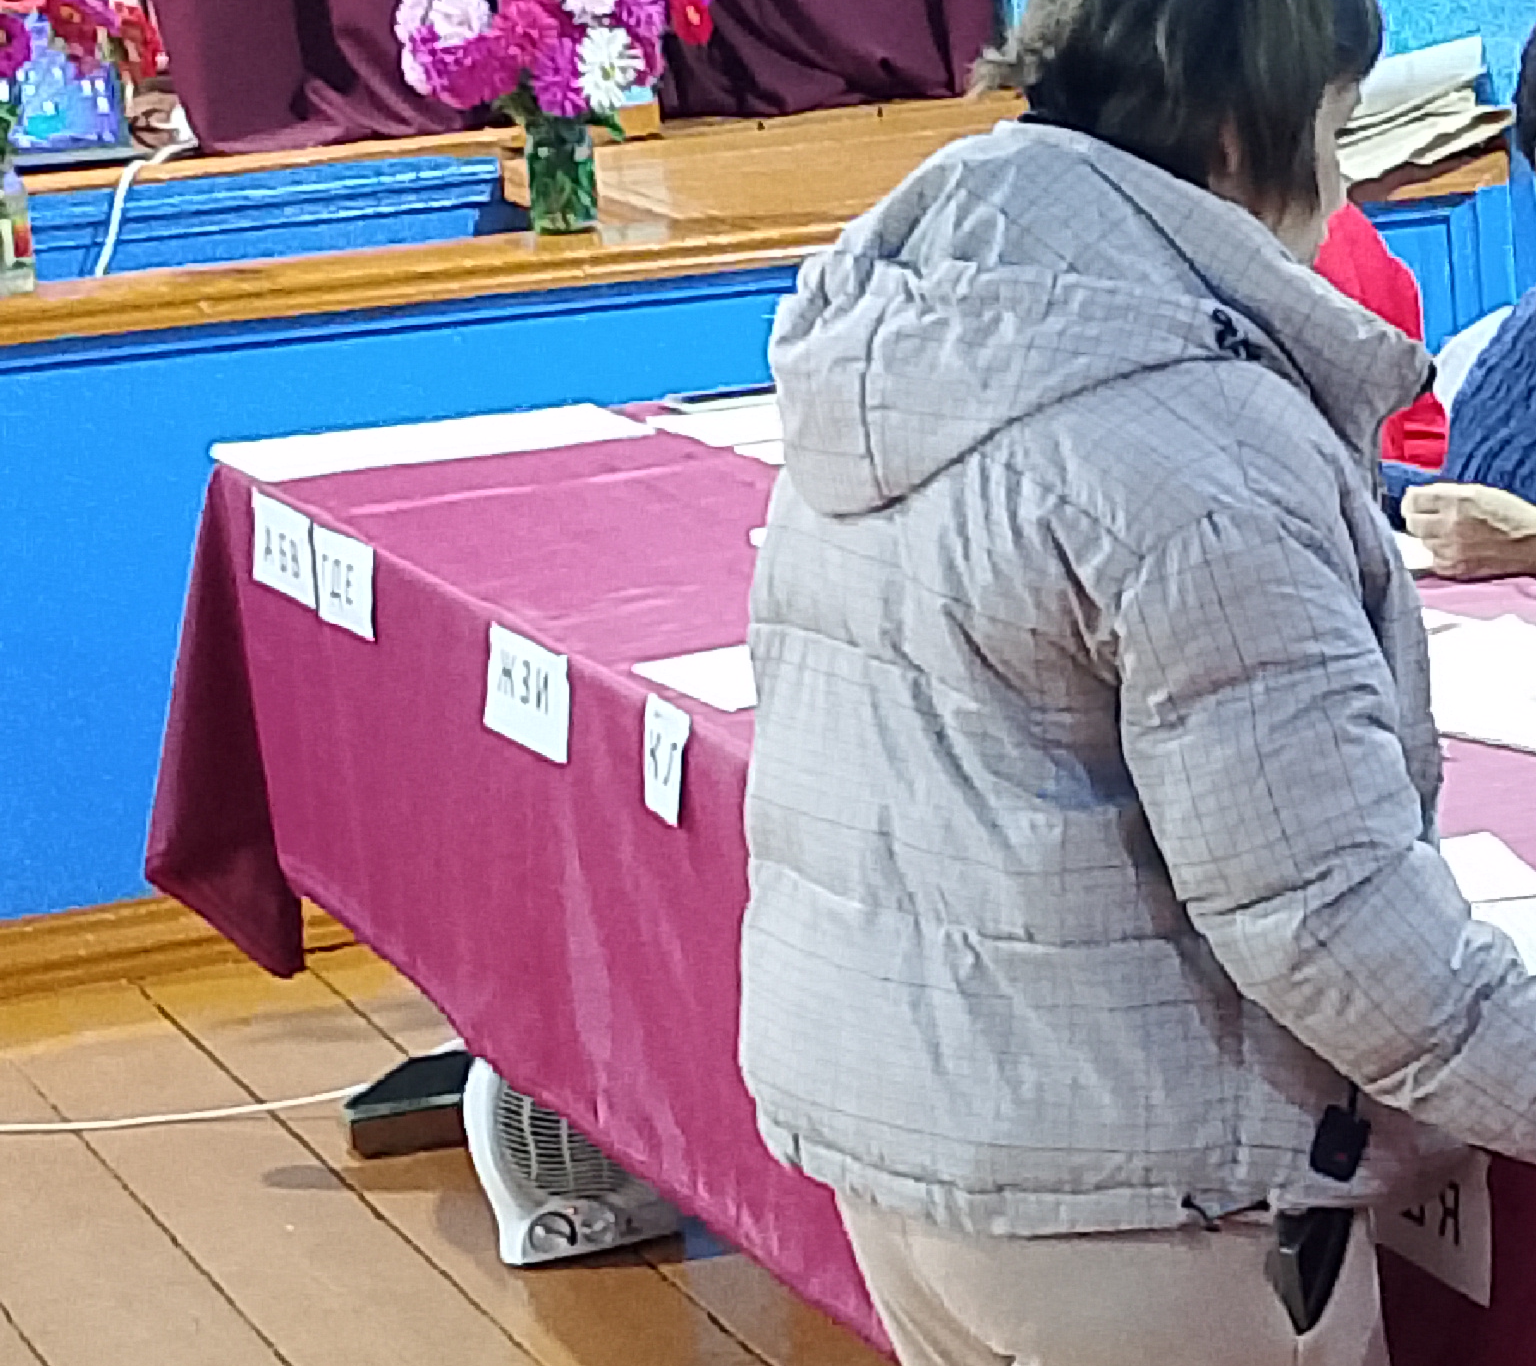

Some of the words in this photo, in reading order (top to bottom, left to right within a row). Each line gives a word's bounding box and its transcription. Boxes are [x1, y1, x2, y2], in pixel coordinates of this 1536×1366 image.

[263, 524, 301, 580] АБВ
[321, 553, 354, 608] ГДЕ
[496, 649, 550, 716] ЖЗИ
